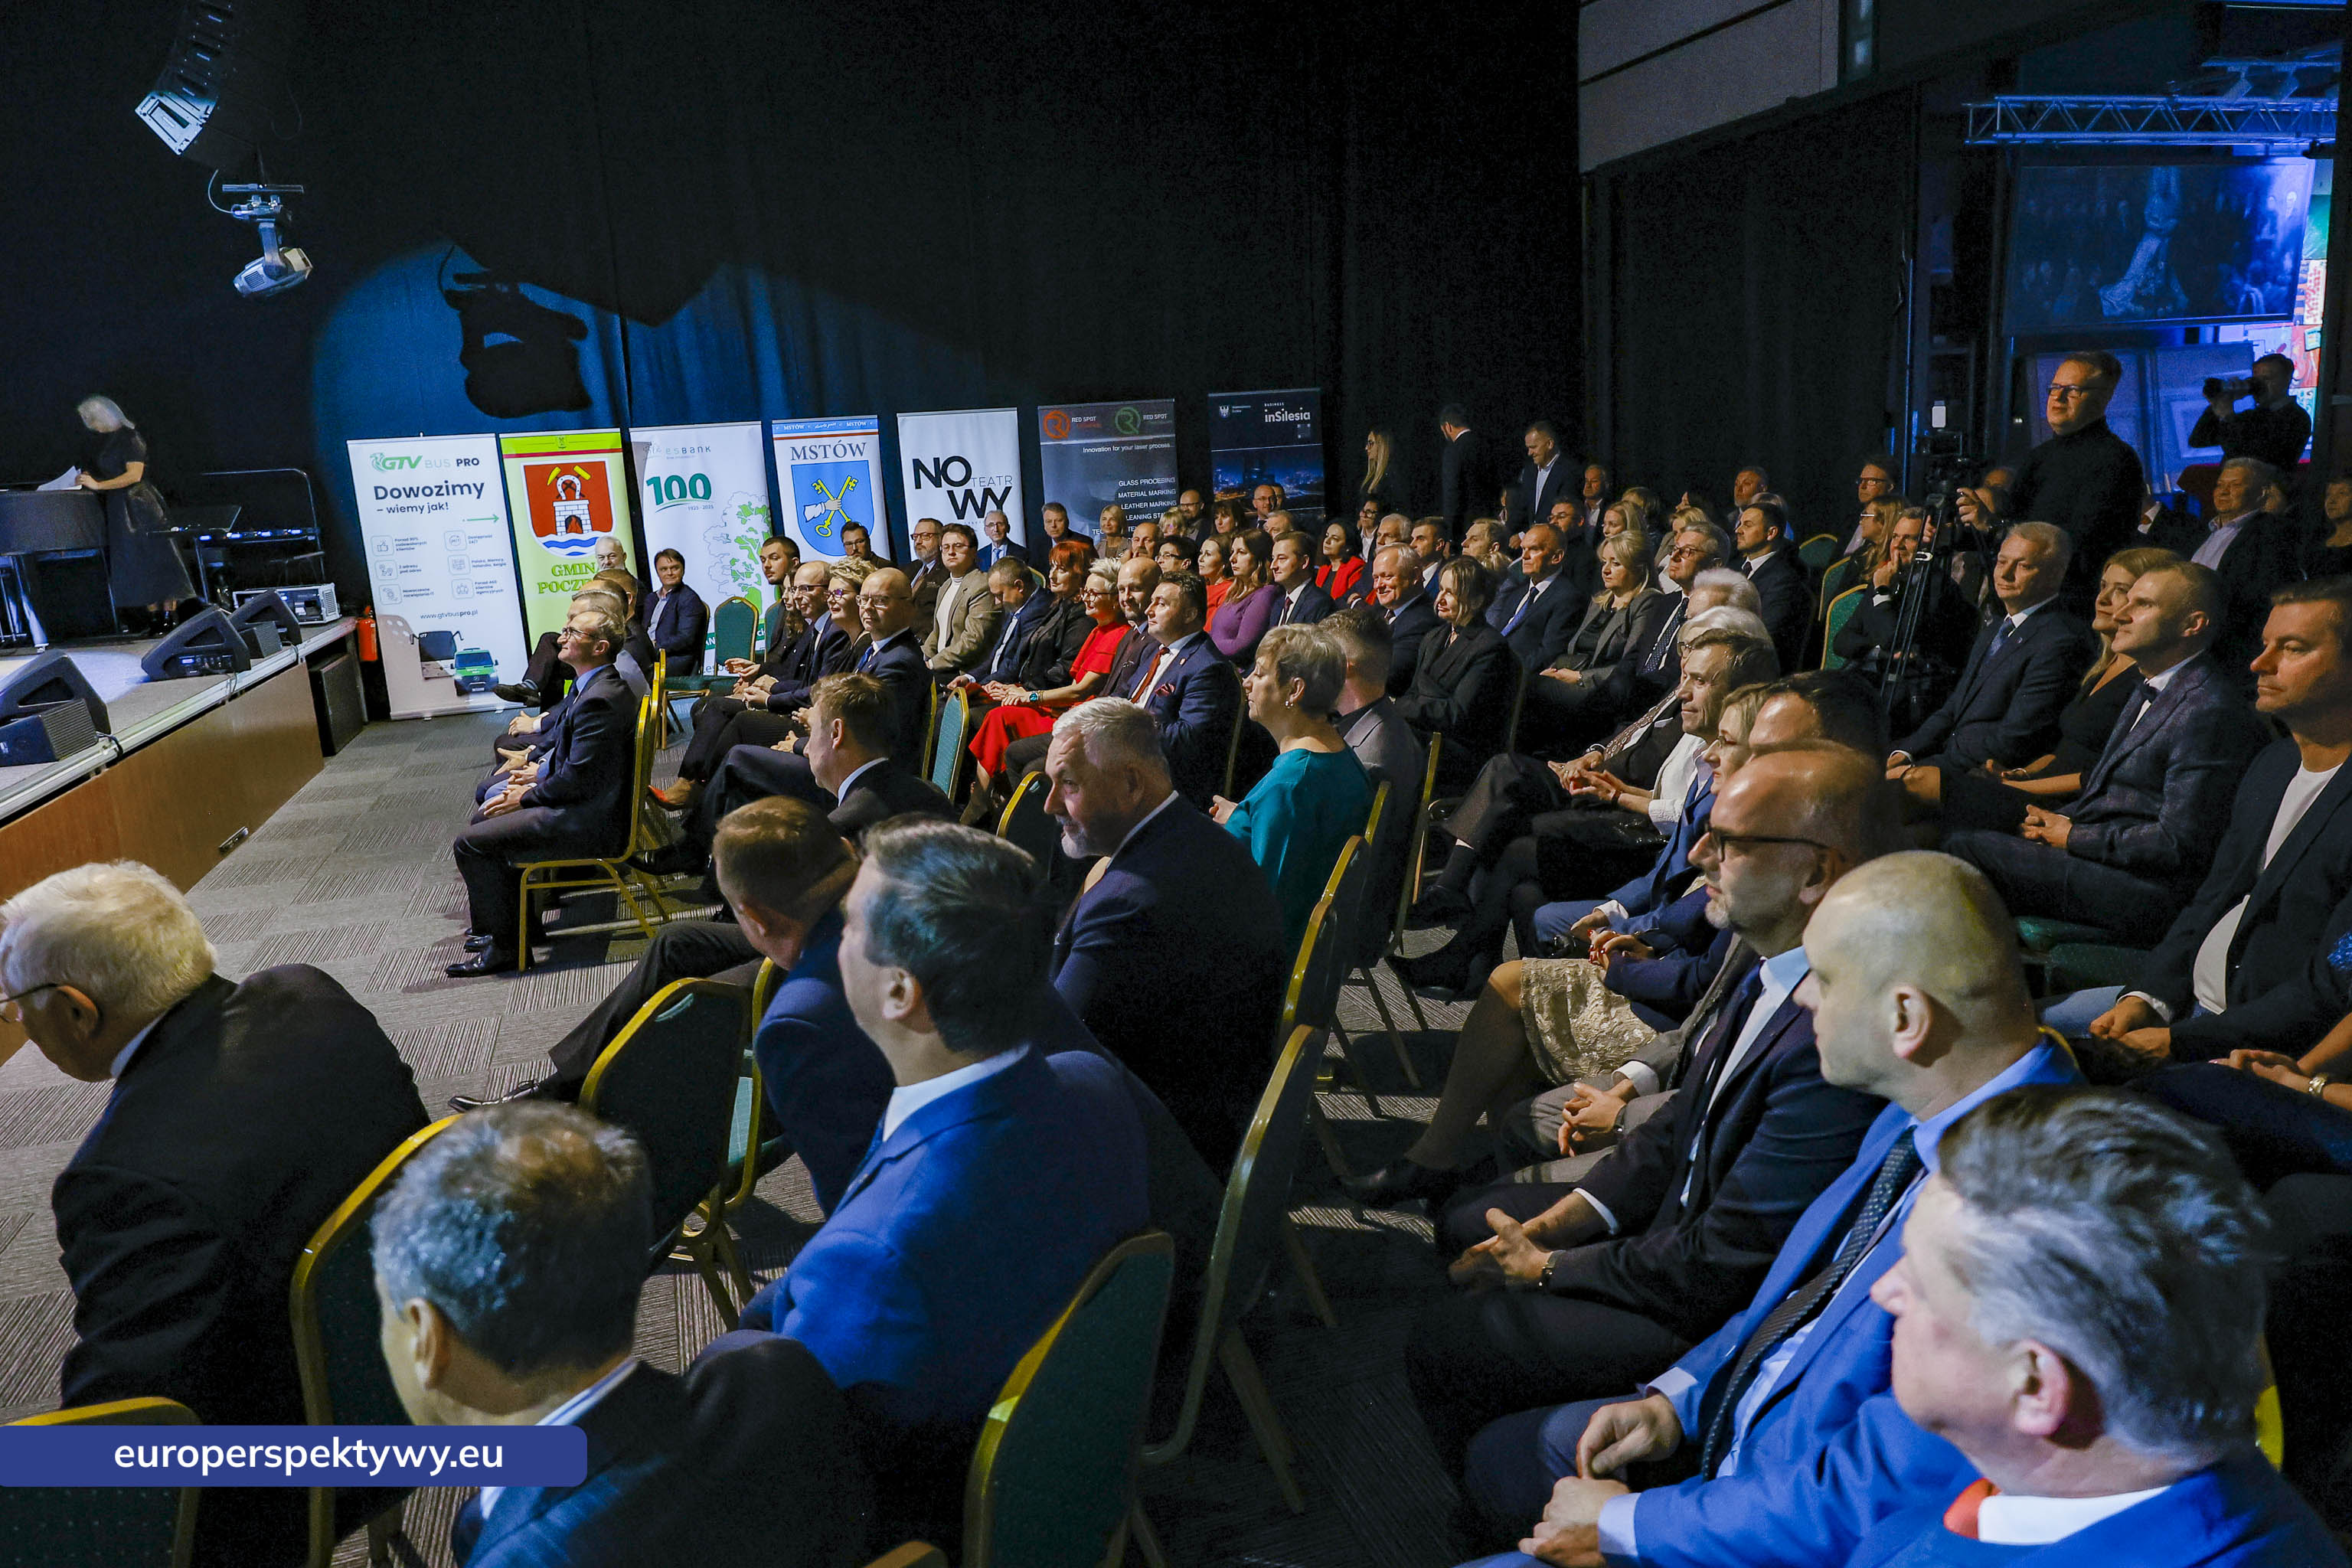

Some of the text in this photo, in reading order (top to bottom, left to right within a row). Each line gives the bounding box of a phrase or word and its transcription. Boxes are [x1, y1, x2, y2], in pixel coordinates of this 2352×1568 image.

[1264, 407, 1311, 423] inSilesia
[790, 439, 867, 461] MSTÓW
[382, 455, 480, 470] GTV BUS PRO
[912, 455, 972, 489] NO
[374, 479, 485, 500] Dowozimy
[645, 472, 712, 506] 100
[970, 475, 1013, 488] TEATR
[386, 502, 449, 514] wiemy jak!
[946, 485, 1013, 520] WY
[551, 562, 599, 577] GMIN
